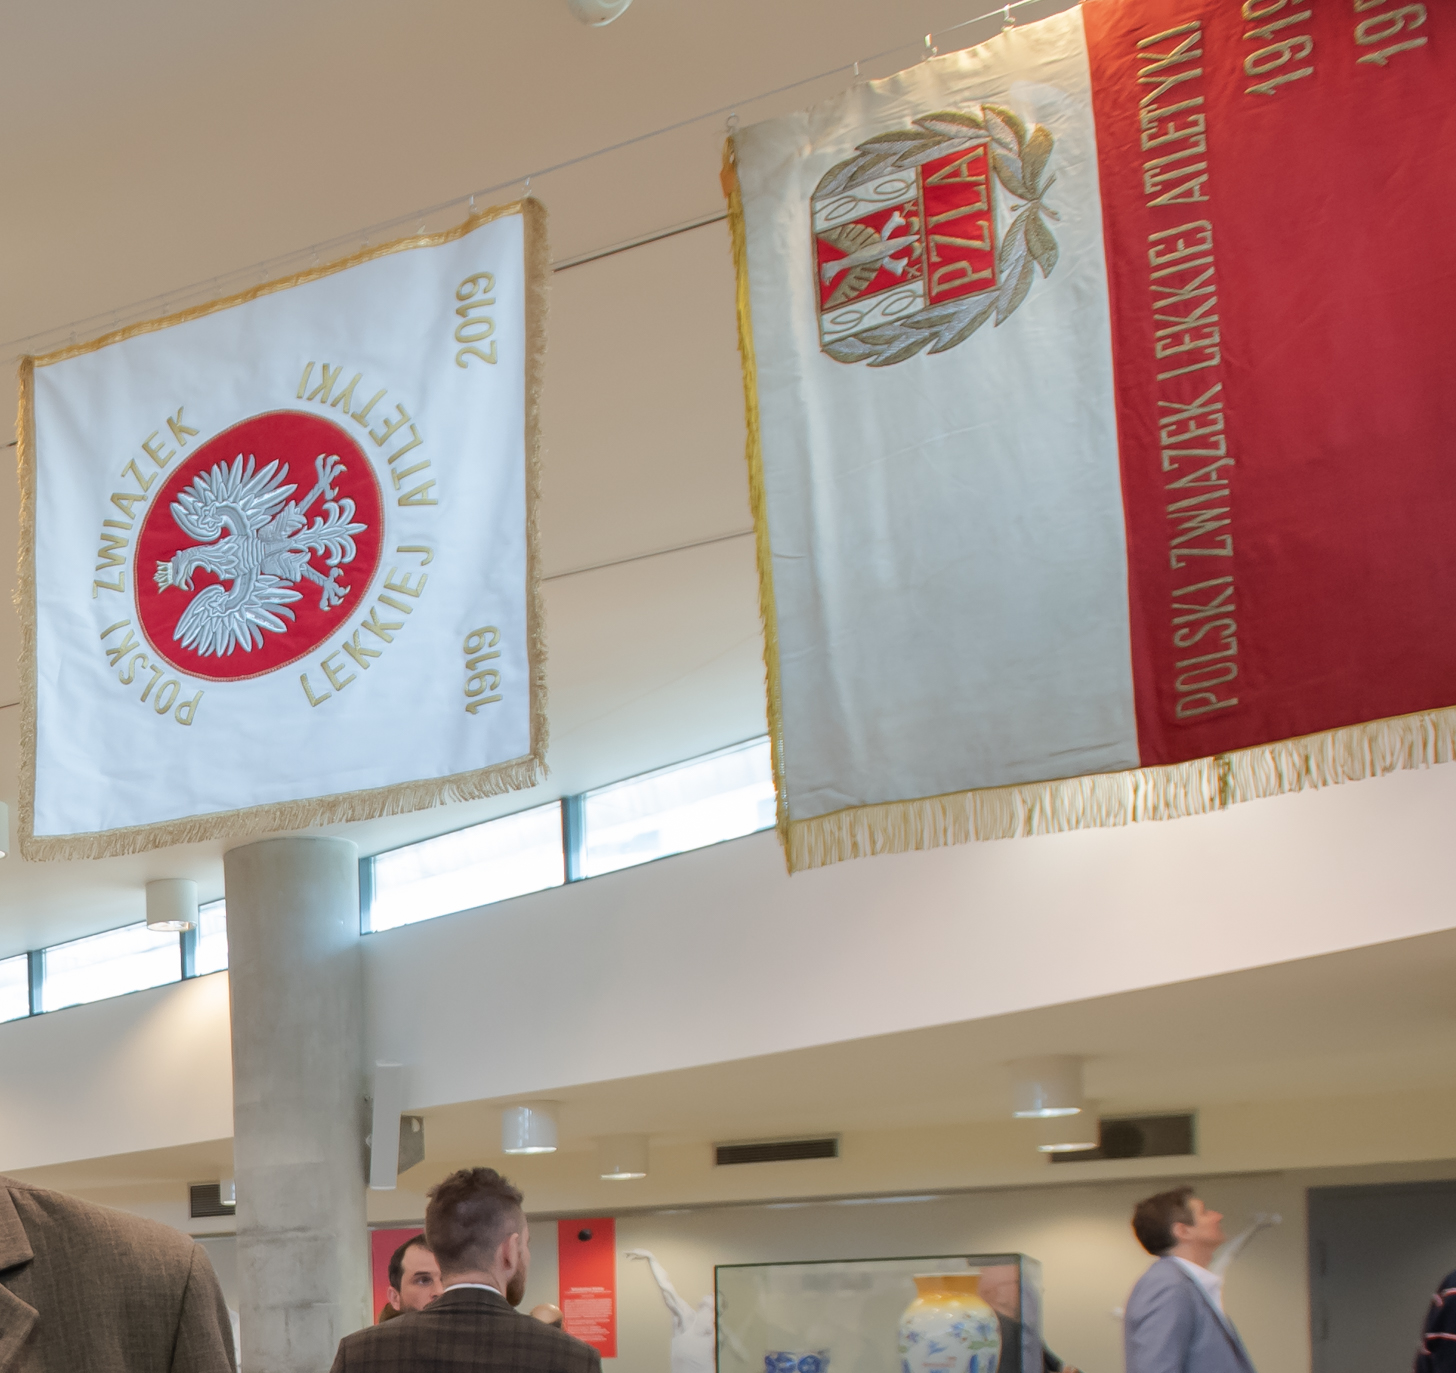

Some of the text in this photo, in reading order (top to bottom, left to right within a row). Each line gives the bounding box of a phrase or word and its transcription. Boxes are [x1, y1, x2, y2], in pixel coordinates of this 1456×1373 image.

[455, 271, 498, 370] 2019
[1136, 20, 1239, 719] POLSKI ZWIĄZEK LEKKIEJ ATLETYKI
[296, 360, 439, 708] LEKKIEJ ATLETYKI
[100, 619, 205, 726] POLSKI
[463, 625, 503, 716] 1919
